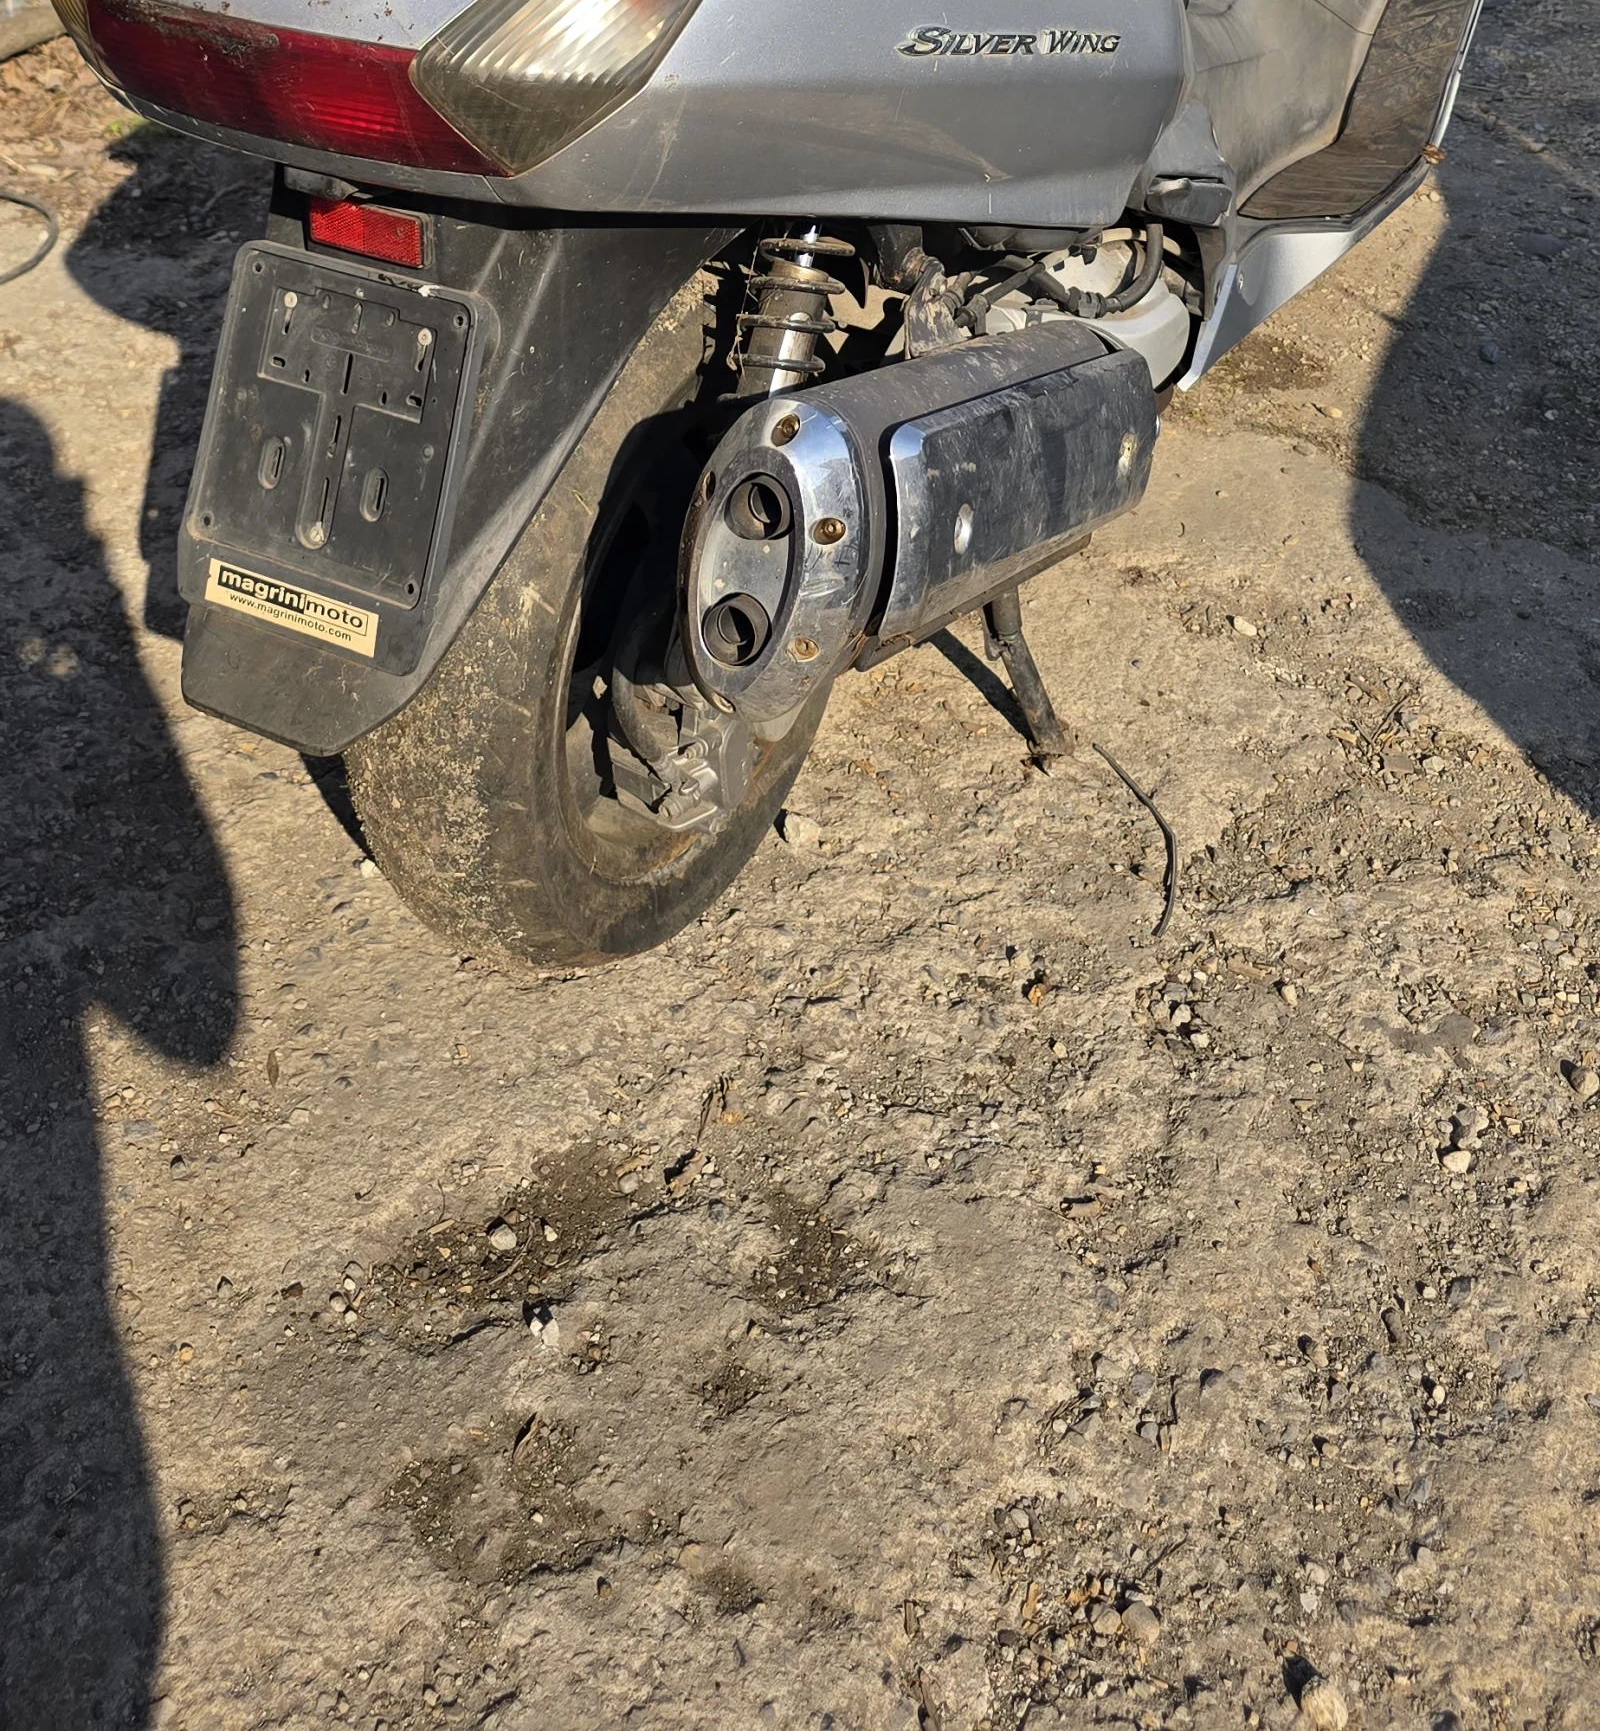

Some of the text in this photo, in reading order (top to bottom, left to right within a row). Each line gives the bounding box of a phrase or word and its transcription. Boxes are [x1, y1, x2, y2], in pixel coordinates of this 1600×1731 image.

[896, 24, 1122, 56] SILVER WING
[229, 592, 352, 642] www.magrinimoto.com
